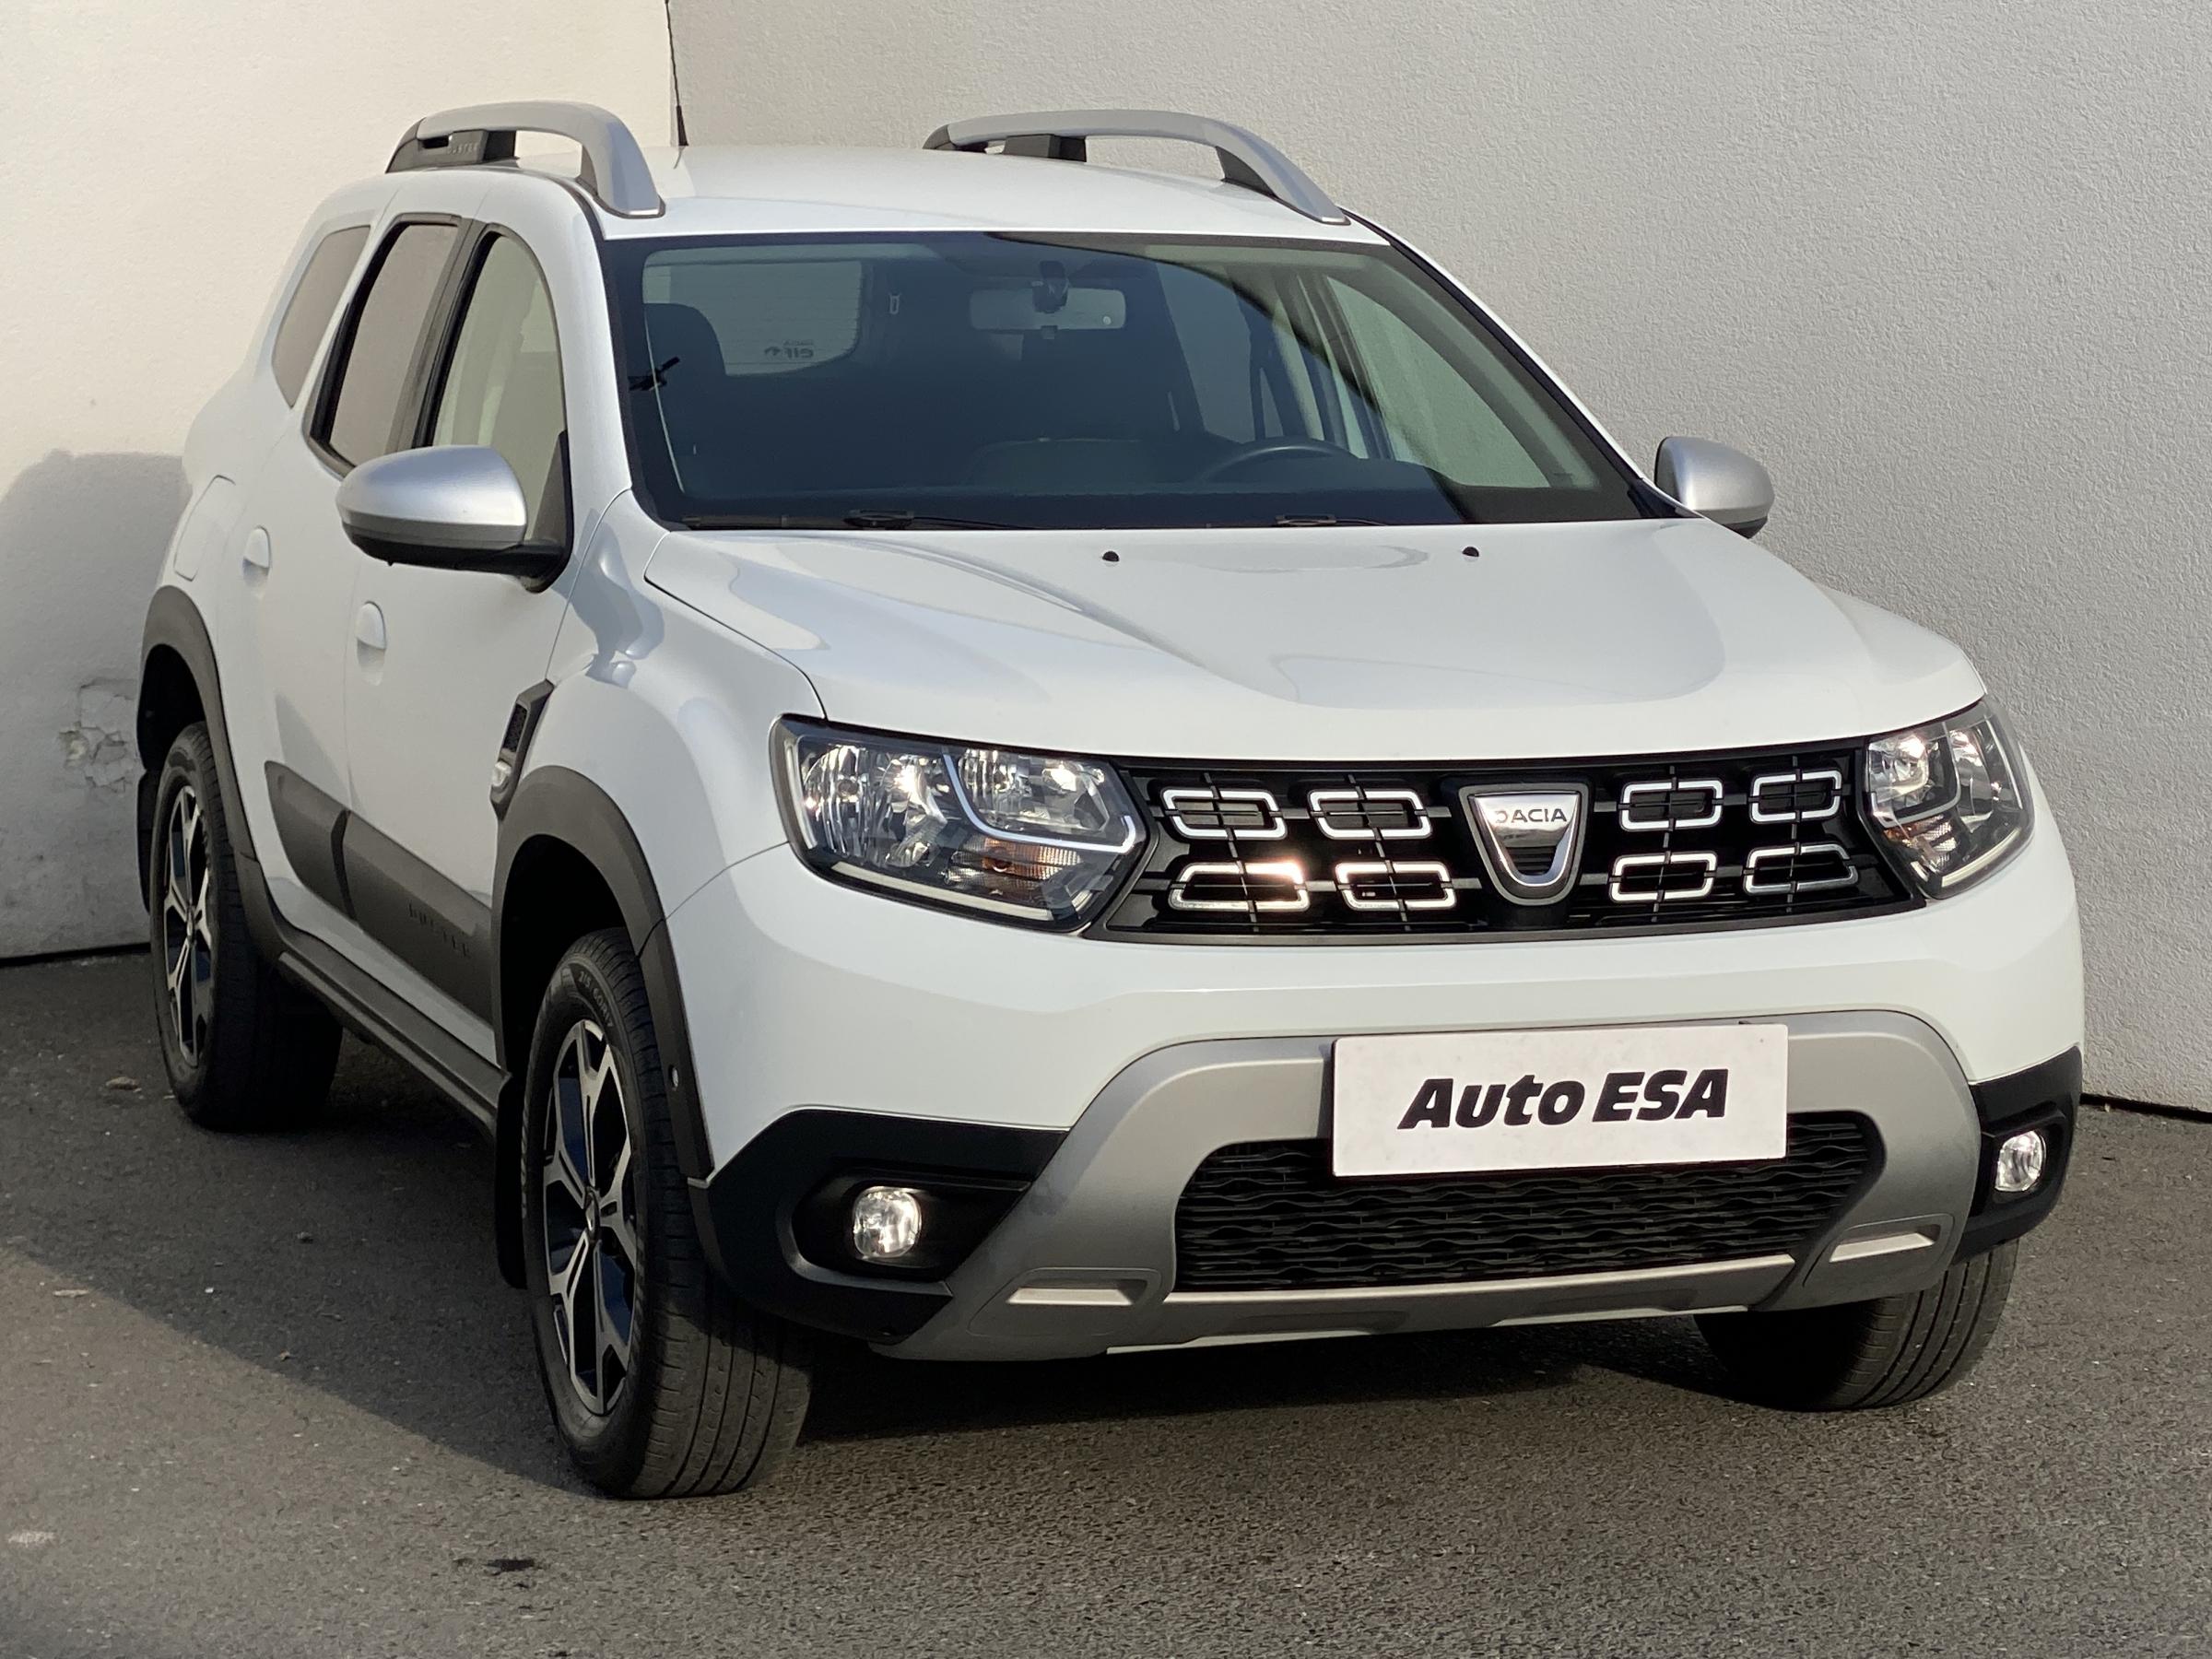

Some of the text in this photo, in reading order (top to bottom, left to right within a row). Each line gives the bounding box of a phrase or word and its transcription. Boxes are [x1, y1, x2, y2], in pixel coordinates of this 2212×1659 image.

[1494, 807, 1568, 823] DACIA
[1396, 1068, 1729, 1130] Auto ESA
